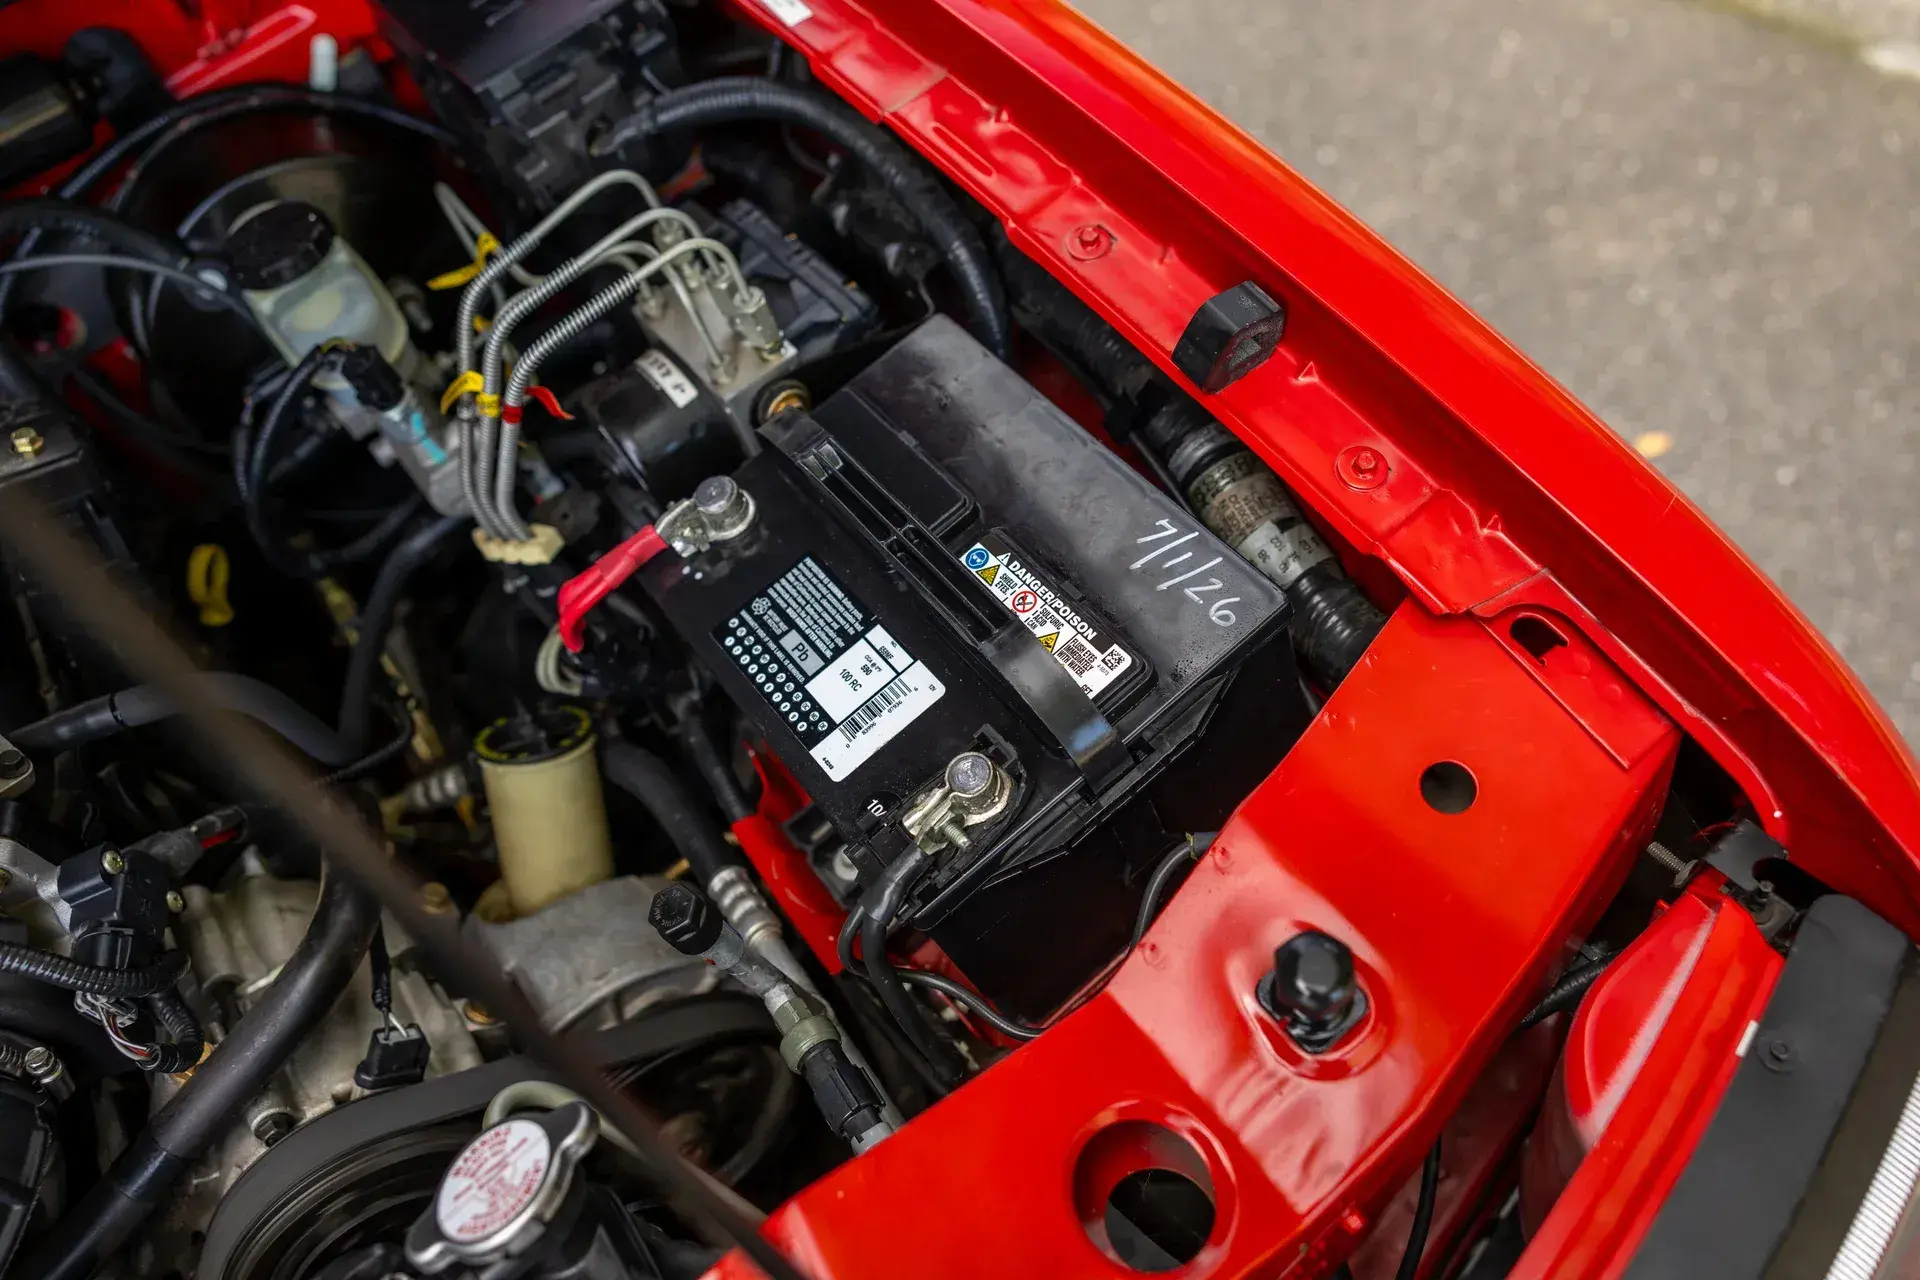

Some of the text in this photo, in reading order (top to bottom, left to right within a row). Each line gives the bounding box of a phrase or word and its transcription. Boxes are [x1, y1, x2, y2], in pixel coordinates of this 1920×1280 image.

[999, 572, 1017, 589] SHIELD
[1128, 518, 1240, 627] 7/1/26
[994, 580, 1009, 595] EYES.
[1008, 560, 1096, 640] DANGER/POISON
[1032, 613, 1047, 626] ACID
[1039, 607, 1064, 630] SULFURIC
[790, 641, 808, 661] Pb
[1062, 643, 1094, 671] IMMEDIATELY
[1069, 637, 1097, 663] FLUSH EYES
[860, 663, 872, 675] 590
[1056, 648, 1086, 678] WITH WATER.
[839, 668, 862, 691] 100 RC
